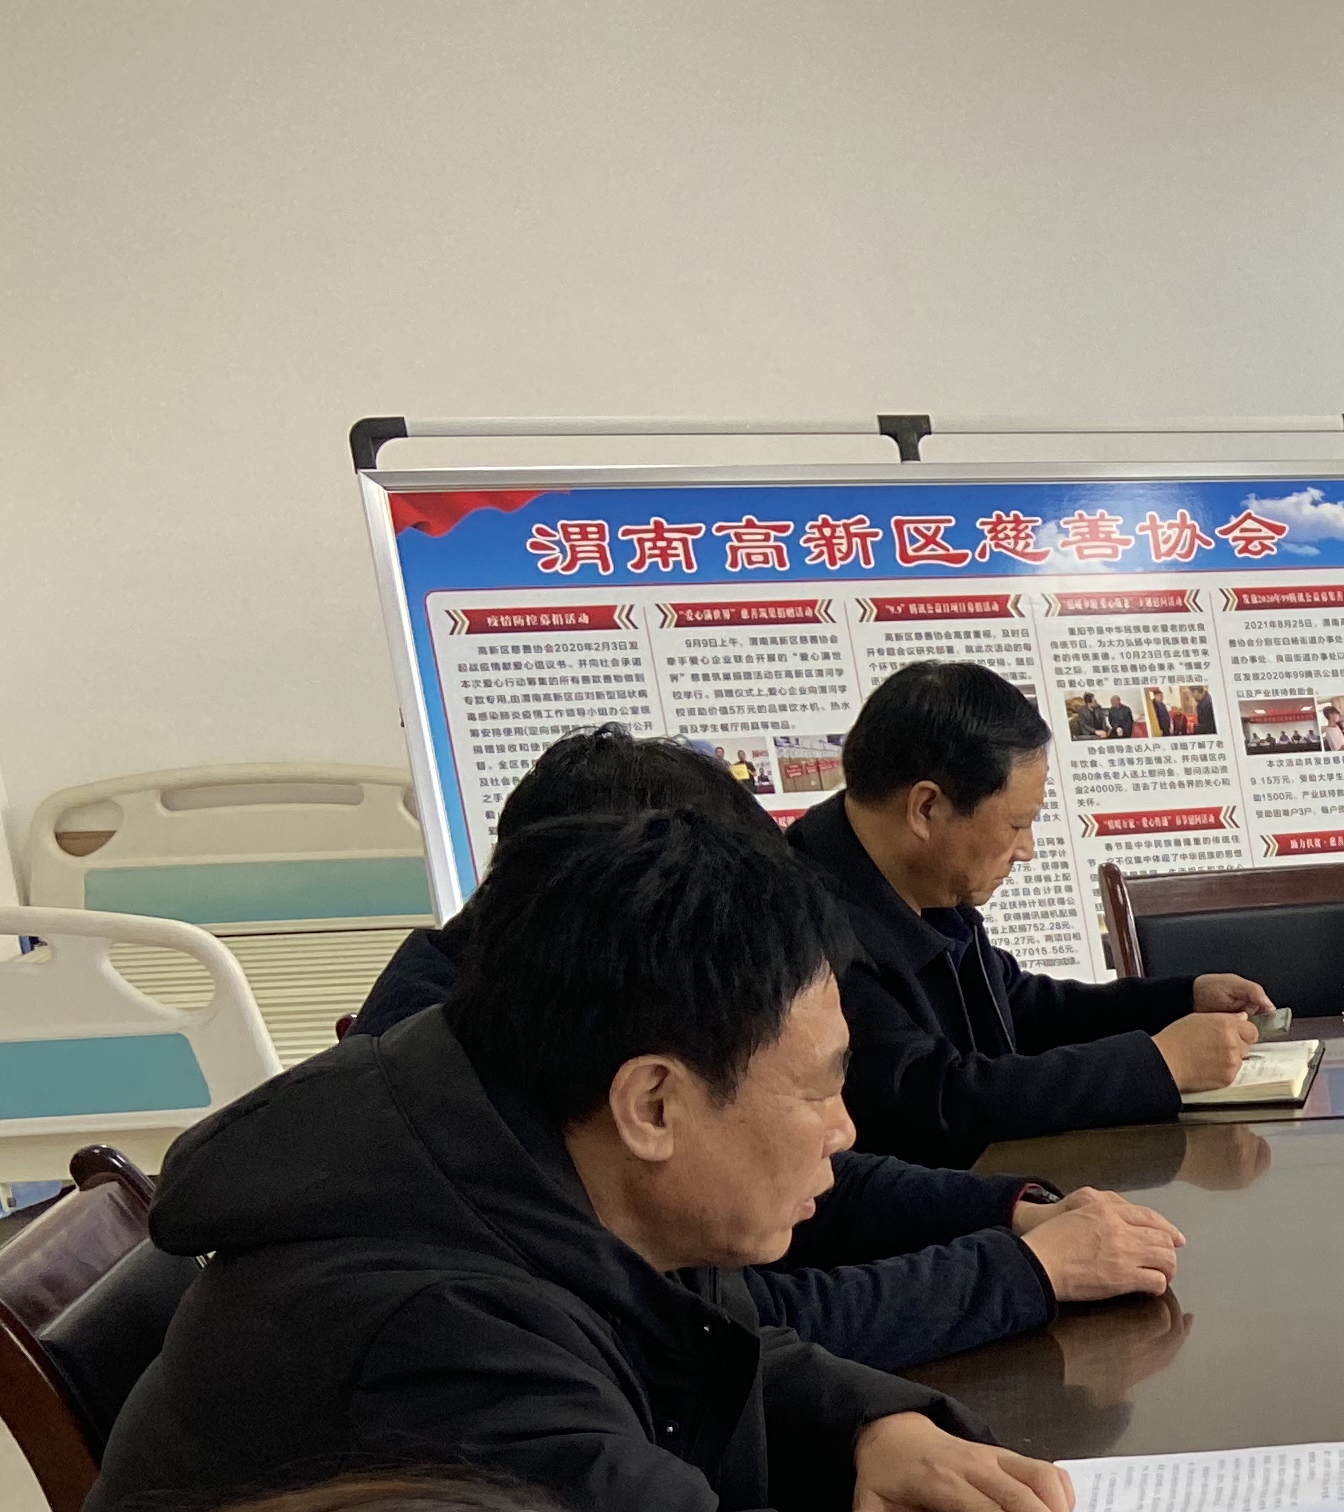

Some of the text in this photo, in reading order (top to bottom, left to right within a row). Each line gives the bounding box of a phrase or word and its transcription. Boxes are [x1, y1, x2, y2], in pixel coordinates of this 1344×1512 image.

[526, 509, 1288, 574] 渭南高新区慈善协会
[487, 612, 590, 627] 疫情防控募捐活动
[477, 641, 639, 656] 高新区慈善协会2020年2月3日发
